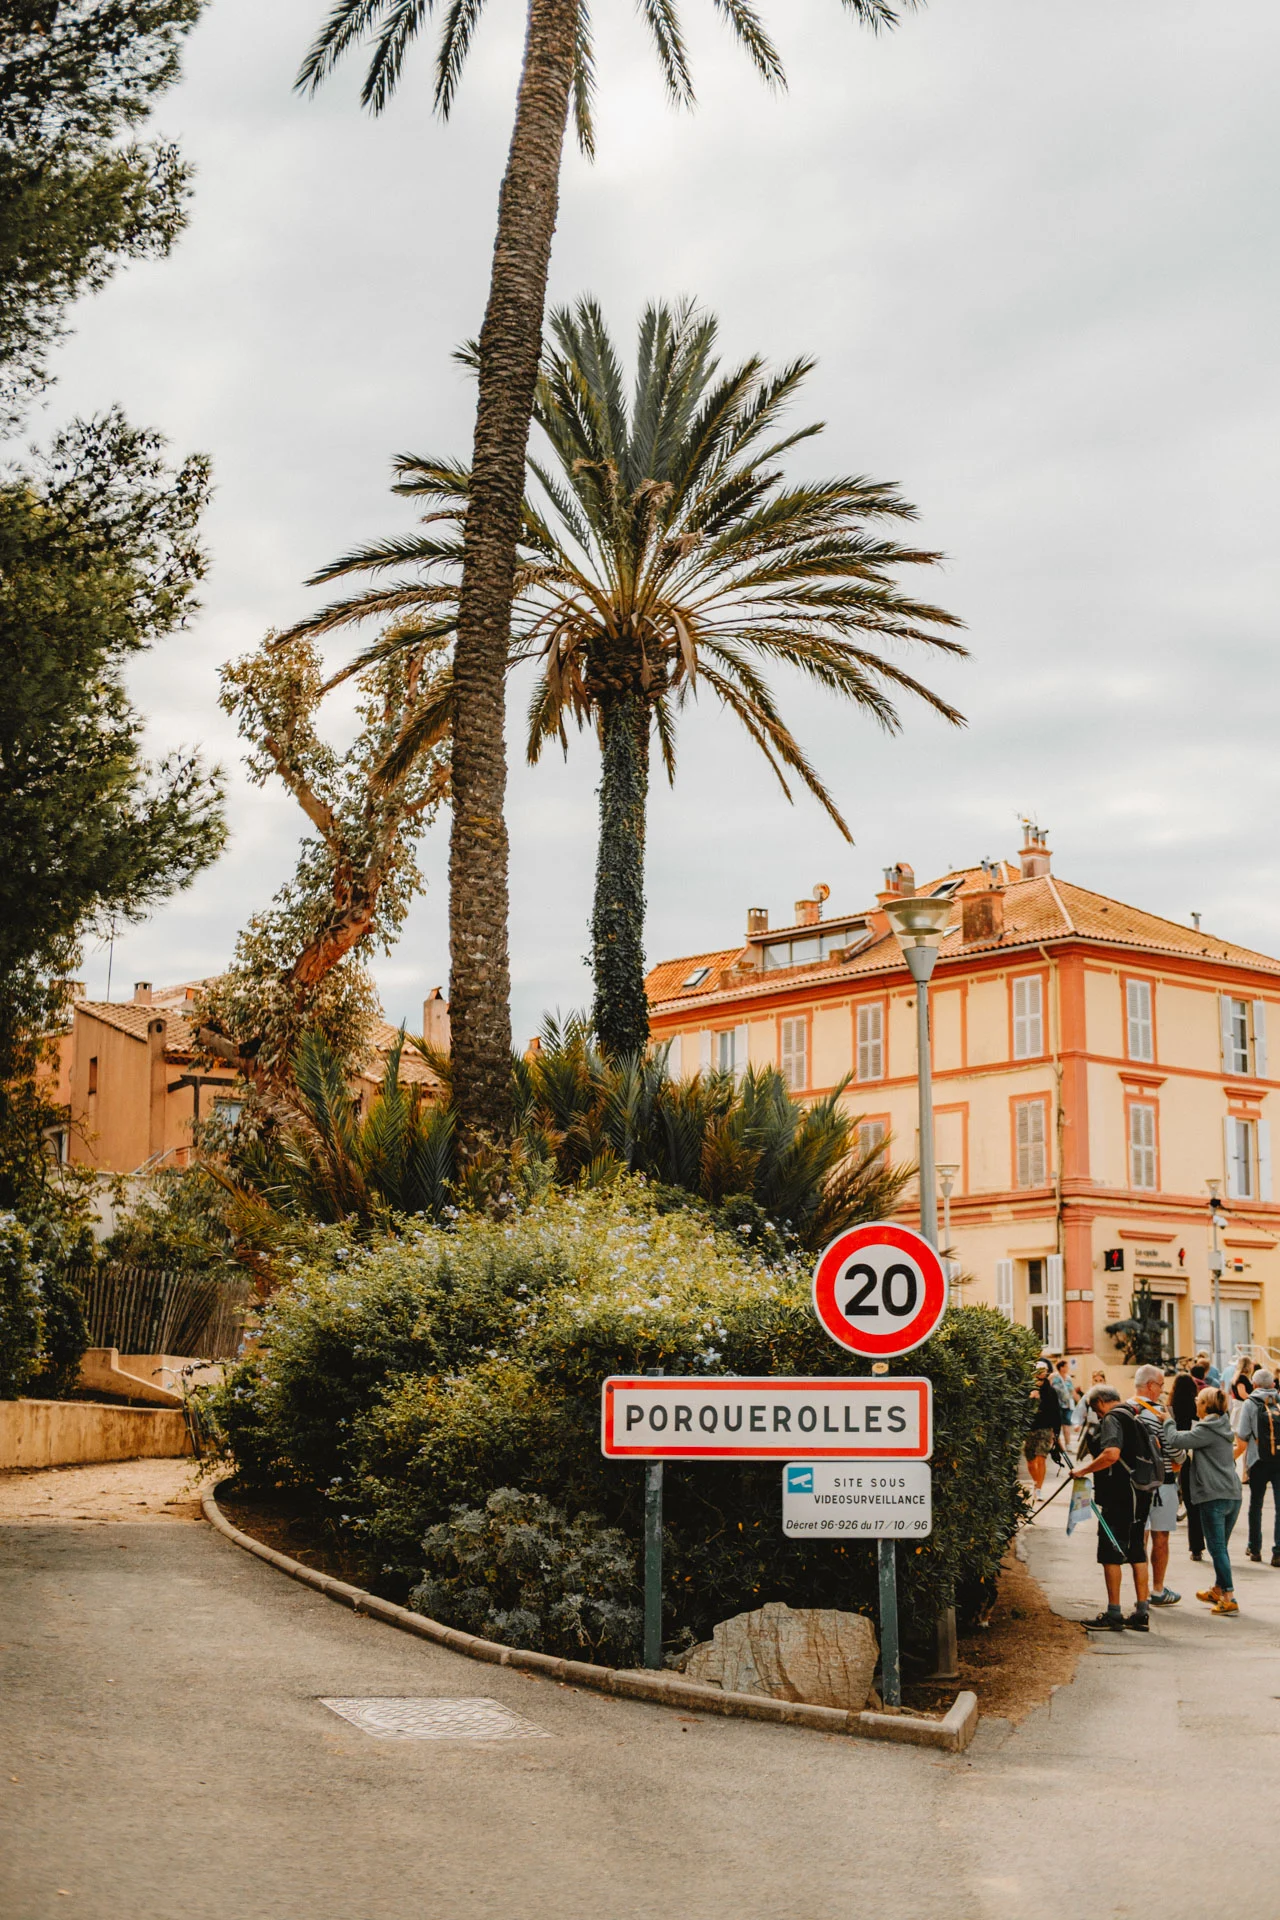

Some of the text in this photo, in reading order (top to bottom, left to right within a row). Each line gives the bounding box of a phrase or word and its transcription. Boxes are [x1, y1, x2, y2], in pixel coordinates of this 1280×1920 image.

[844, 1263, 918, 1317] 20
[626, 1404, 907, 1434] PORQUEROLLES
[834, 1477, 906, 1488] SITE SOUS
[814, 1494, 926, 1505] VIDEOSURVEILLANCE
[786, 1519, 818, 1530] Décret
[820, 1519, 858, 1530] 96-926
[860, 1520, 872, 1530] du
